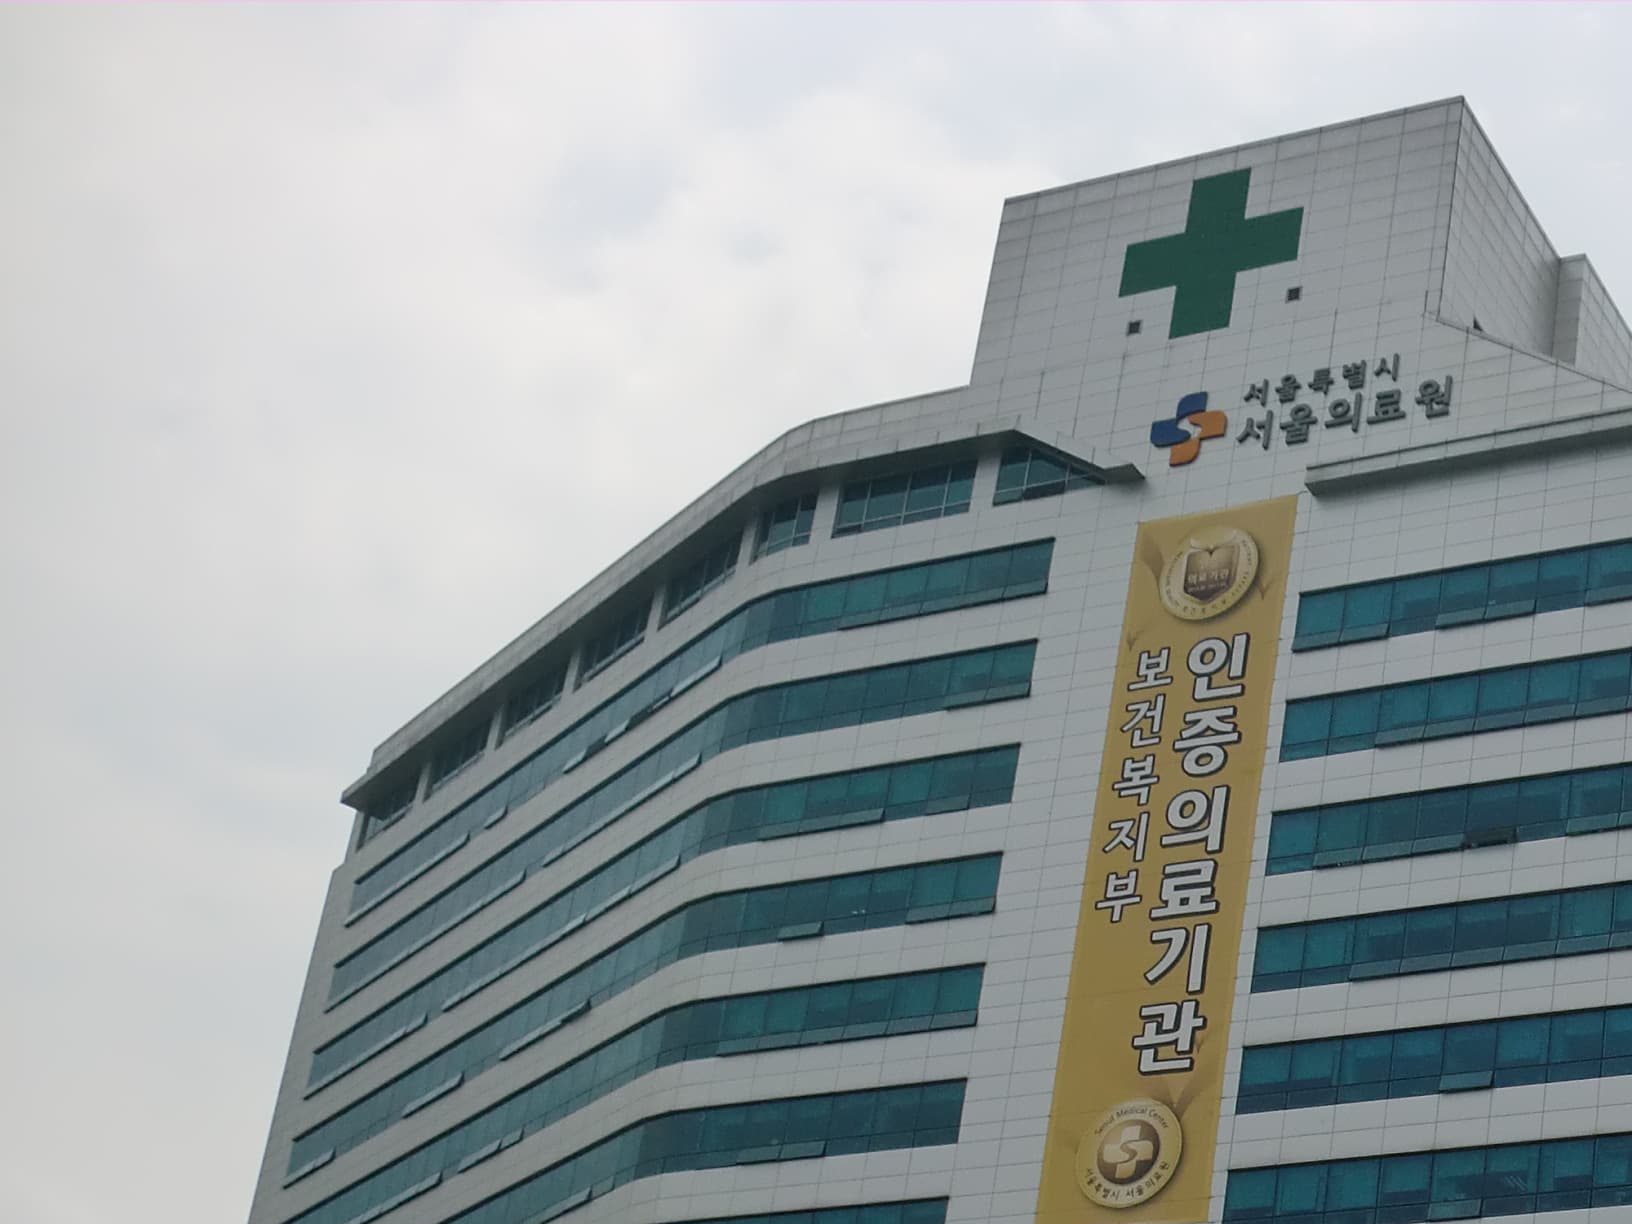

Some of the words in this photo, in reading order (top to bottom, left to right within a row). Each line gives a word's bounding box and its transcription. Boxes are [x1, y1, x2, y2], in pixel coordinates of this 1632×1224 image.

[1235, 375, 1453, 450] 서울의료원
[1244, 353, 1400, 408] 서울특별시
[1094, 646, 1174, 923] 보건복지부
[1132, 632, 1251, 1076] 인증의료기관
[1116, 1106, 1148, 1118] Medical
[1148, 1108, 1169, 1129] Center
